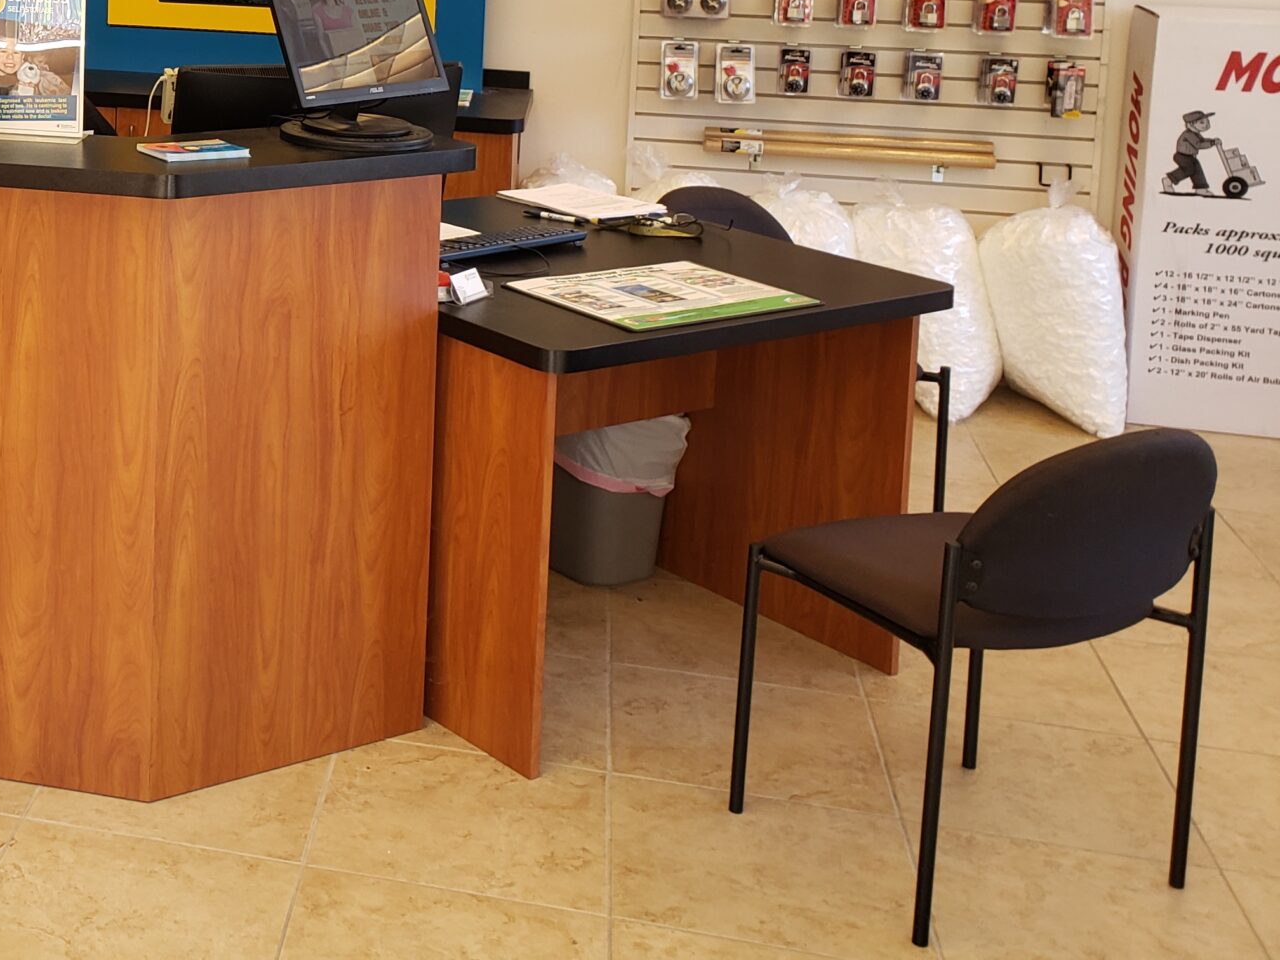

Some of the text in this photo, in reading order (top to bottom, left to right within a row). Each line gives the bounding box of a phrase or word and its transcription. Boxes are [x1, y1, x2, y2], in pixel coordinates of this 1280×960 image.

[1120, 70, 1144, 252] MOVING
[1161, 221, 1280, 242] Packs approx
[1204, 242, 1250, 257] 1000
[1164, 270, 1174, 278] 12
[1267, 278, 1276, 286] 12
[1174, 308, 1210, 319] Marking
[1213, 311, 1230, 320] Pen
[1173, 320, 1196, 329] Rolls
[1199, 322, 1208, 330] of
[1231, 324, 1241, 332] 55
[1244, 325, 1265, 335] Yard
[1172, 332, 1194, 342] Tape
[1196, 334, 1241, 345] Dispenser
[1171, 344, 1197, 353] Glass
[1199, 347, 1235, 358] Packing
[1237, 350, 1251, 358] Kit
[1158, 355, 1162, 363] 1
[1170, 356, 1191, 365] Dish
[1193, 358, 1229, 369] Packing
[1231, 361, 1244, 370] Kit
[1210, 372, 1233, 380] Rolls
[1235, 374, 1245, 382] of
[1247, 375, 1260, 384] Air
